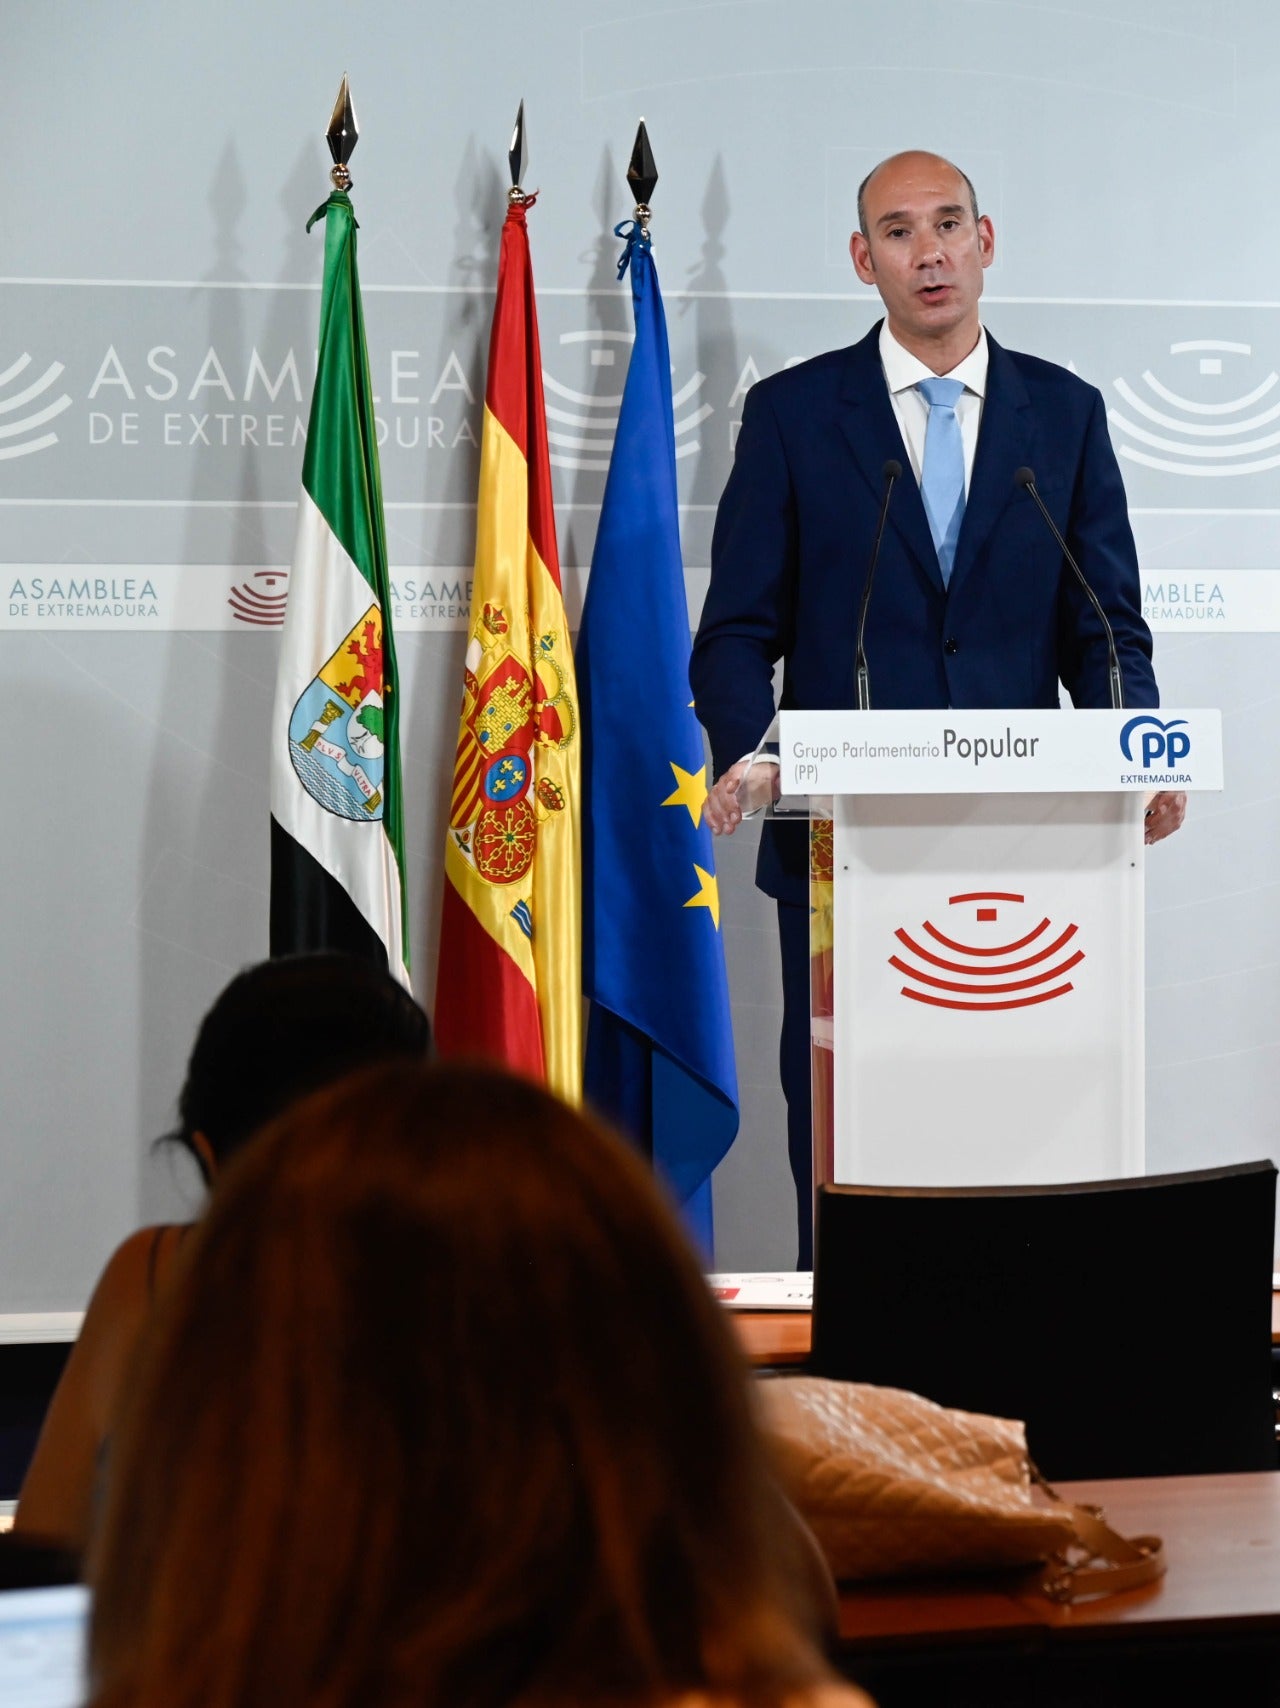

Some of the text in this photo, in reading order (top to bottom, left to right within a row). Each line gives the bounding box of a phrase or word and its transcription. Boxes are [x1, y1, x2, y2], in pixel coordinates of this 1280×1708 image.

[87, 343, 475, 404] ASAMEA
[89, 412, 140, 445] DE
[9, 578, 159, 600] ASAMBLEA
[1144, 583, 1225, 603] MBLEA
[9, 603, 160, 617] DE EXTREMADURA
[410, 605, 471, 618] EXTREM
[1143, 606, 1226, 620] REMADURA
[793, 727, 1040, 766] Grupo Parlamentario Popular
[794, 763, 819, 784] (PP)
[1120, 774, 1192, 784] EXTREMADURA
